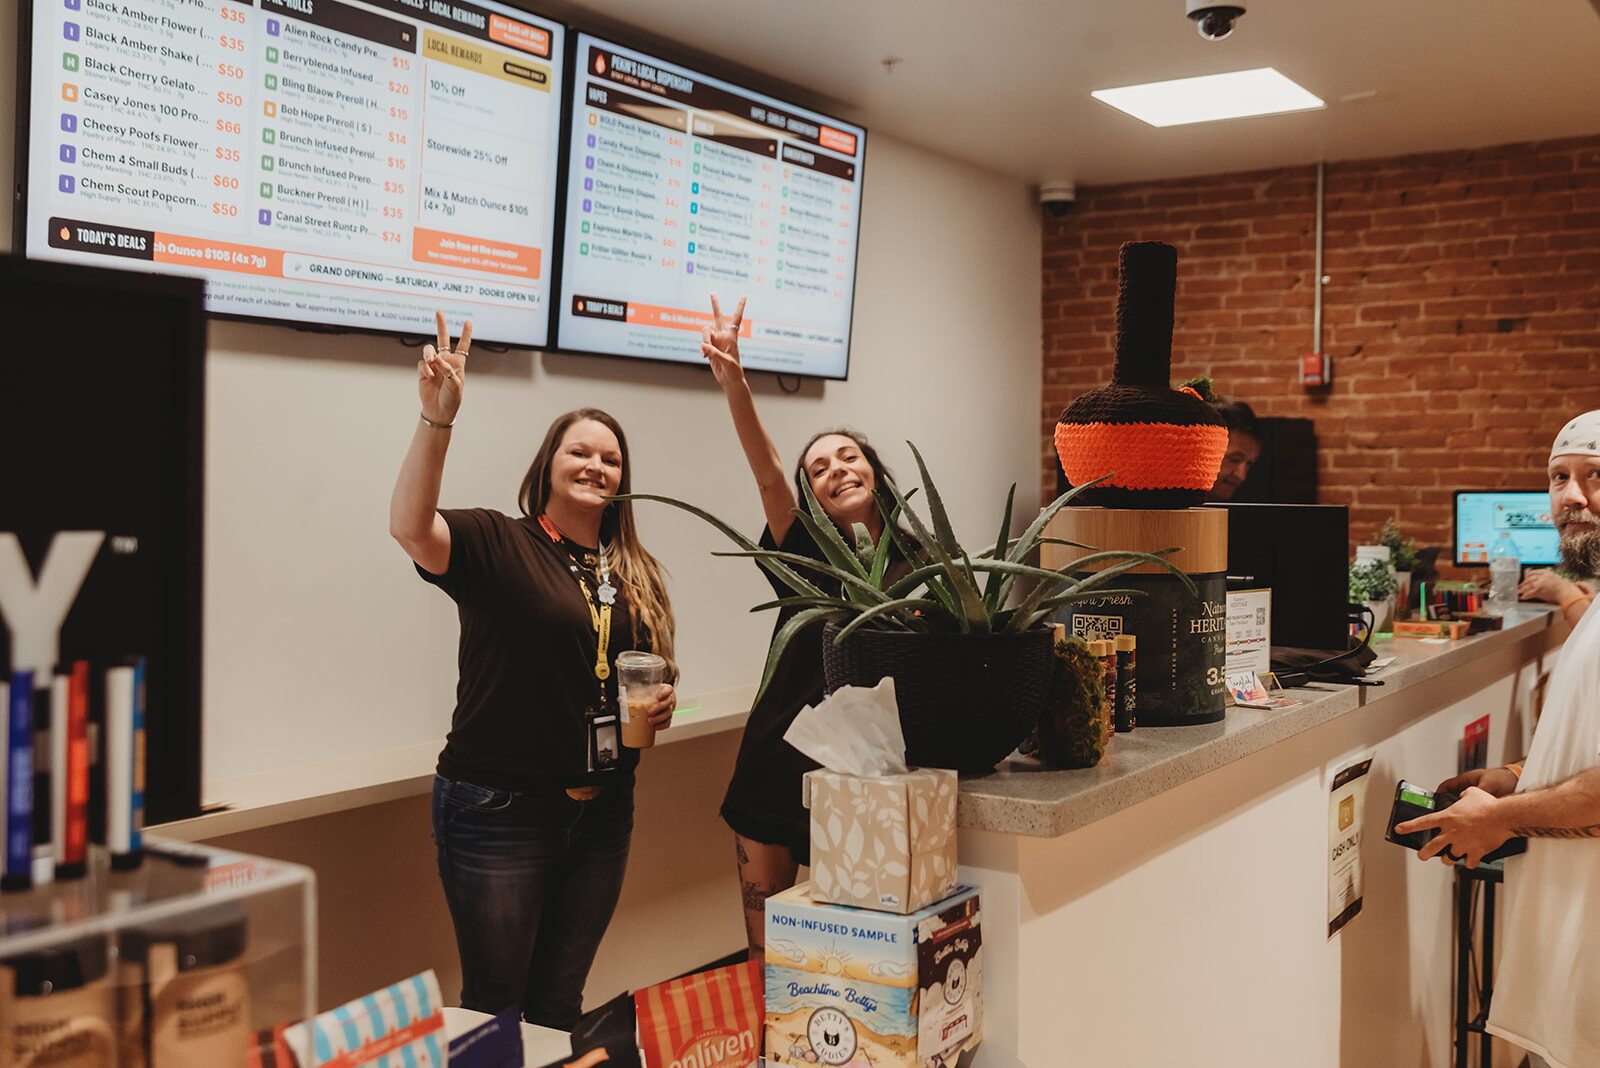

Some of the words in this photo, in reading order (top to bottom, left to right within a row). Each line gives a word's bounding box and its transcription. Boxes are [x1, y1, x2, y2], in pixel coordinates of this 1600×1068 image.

[86, 0, 118, 14] Black
[121, 8, 158, 25] Amber
[161, 17, 198, 35] Flower
[220, 7, 246, 24] $35
[429, 0, 451, 18] LOCAL
[452, 7, 485, 29] REWARDS
[85, 27, 117, 43] Black
[121, 36, 158, 53] Amber
[161, 46, 193, 63] Shake
[220, 35, 245, 52] $35
[284, 23, 308, 38] Alien
[310, 30, 332, 44] Rock
[334, 38, 362, 55] Candy
[428, 37, 449, 55] LOCAL
[451, 47, 483, 64] REWARDS
[85, 56, 116, 73] Black
[119, 66, 158, 84] Cherry
[160, 76, 195, 92] Gelato
[218, 63, 243, 79] $50
[283, 50, 339, 73] Berryblenda
[341, 67, 374, 82] Infused
[392, 56, 410, 70] $15
[282, 77, 306, 92] Bling
[307, 84, 334, 98] Blaow
[336, 91, 364, 106] Preroll
[430, 79, 449, 94] 10%
[452, 85, 465, 97] Off
[84, 87, 120, 105] Casey
[123, 97, 157, 112] Jones
[160, 104, 179, 117] 100
[217, 92, 242, 107] $50
[215, 119, 241, 135] $66
[280, 104, 299, 117] Bob
[301, 108, 324, 122] Hope
[326, 115, 355, 129] Preroll
[83, 117, 127, 136] Cheesy
[129, 127, 161, 142] Poofs
[280, 130, 313, 147] Brunch
[314, 139, 348, 154] Infused
[427, 138, 471, 158] Storewide
[474, 150, 492, 162] 25%
[495, 154, 508, 165] Off
[82, 147, 116, 163] Chem
[118, 155, 125, 164] 4
[129, 156, 159, 171] Small
[161, 163, 188, 176] Buds
[215, 147, 241, 162] $35
[387, 157, 406, 169] $15
[279, 157, 312, 172] Brunch
[313, 165, 347, 180] Infused
[81, 177, 115, 192] Chem
[117, 183, 150, 198] Scout
[213, 174, 239, 189] $60
[384, 181, 404, 194] $35
[277, 184, 315, 199] Buckner
[317, 192, 346, 206] Preroll
[424, 186, 440, 198] Mix
[451, 192, 478, 206] Match
[480, 197, 506, 212] Ounce
[509, 203, 528, 216] $105
[212, 202, 238, 217] $50
[383, 206, 403, 218] $35
[276, 211, 302, 223] Canal
[304, 215, 331, 229] Street
[333, 220, 358, 233] Runtz
[76, 228, 116, 247] TODAY'S
[117, 234, 147, 251] DEALS
[167, 243, 203, 259] Ounce
[205, 247, 230, 262] $105
[309, 263, 343, 277] GRAND
[344, 268, 384, 283] OPENING
[442, 281, 462, 293] JUNE
[479, 286, 505, 298] DOORS
[506, 290, 528, 301] OPEN
[235, 296, 254, 304] reach
[264, 299, 291, 308] children
[308, 304, 337, 314] approved
[1189, 617, 1226, 634] HERIT
[1332, 842, 1346, 861] CASH
[771, 913, 849, 936] NON-INFUSED
[851, 926, 897, 944] SAMPLE
[787, 982, 840, 998] Beachtime
[844, 987, 879, 1012] Betty's
[814, 1014, 849, 1032] BETTY'S
